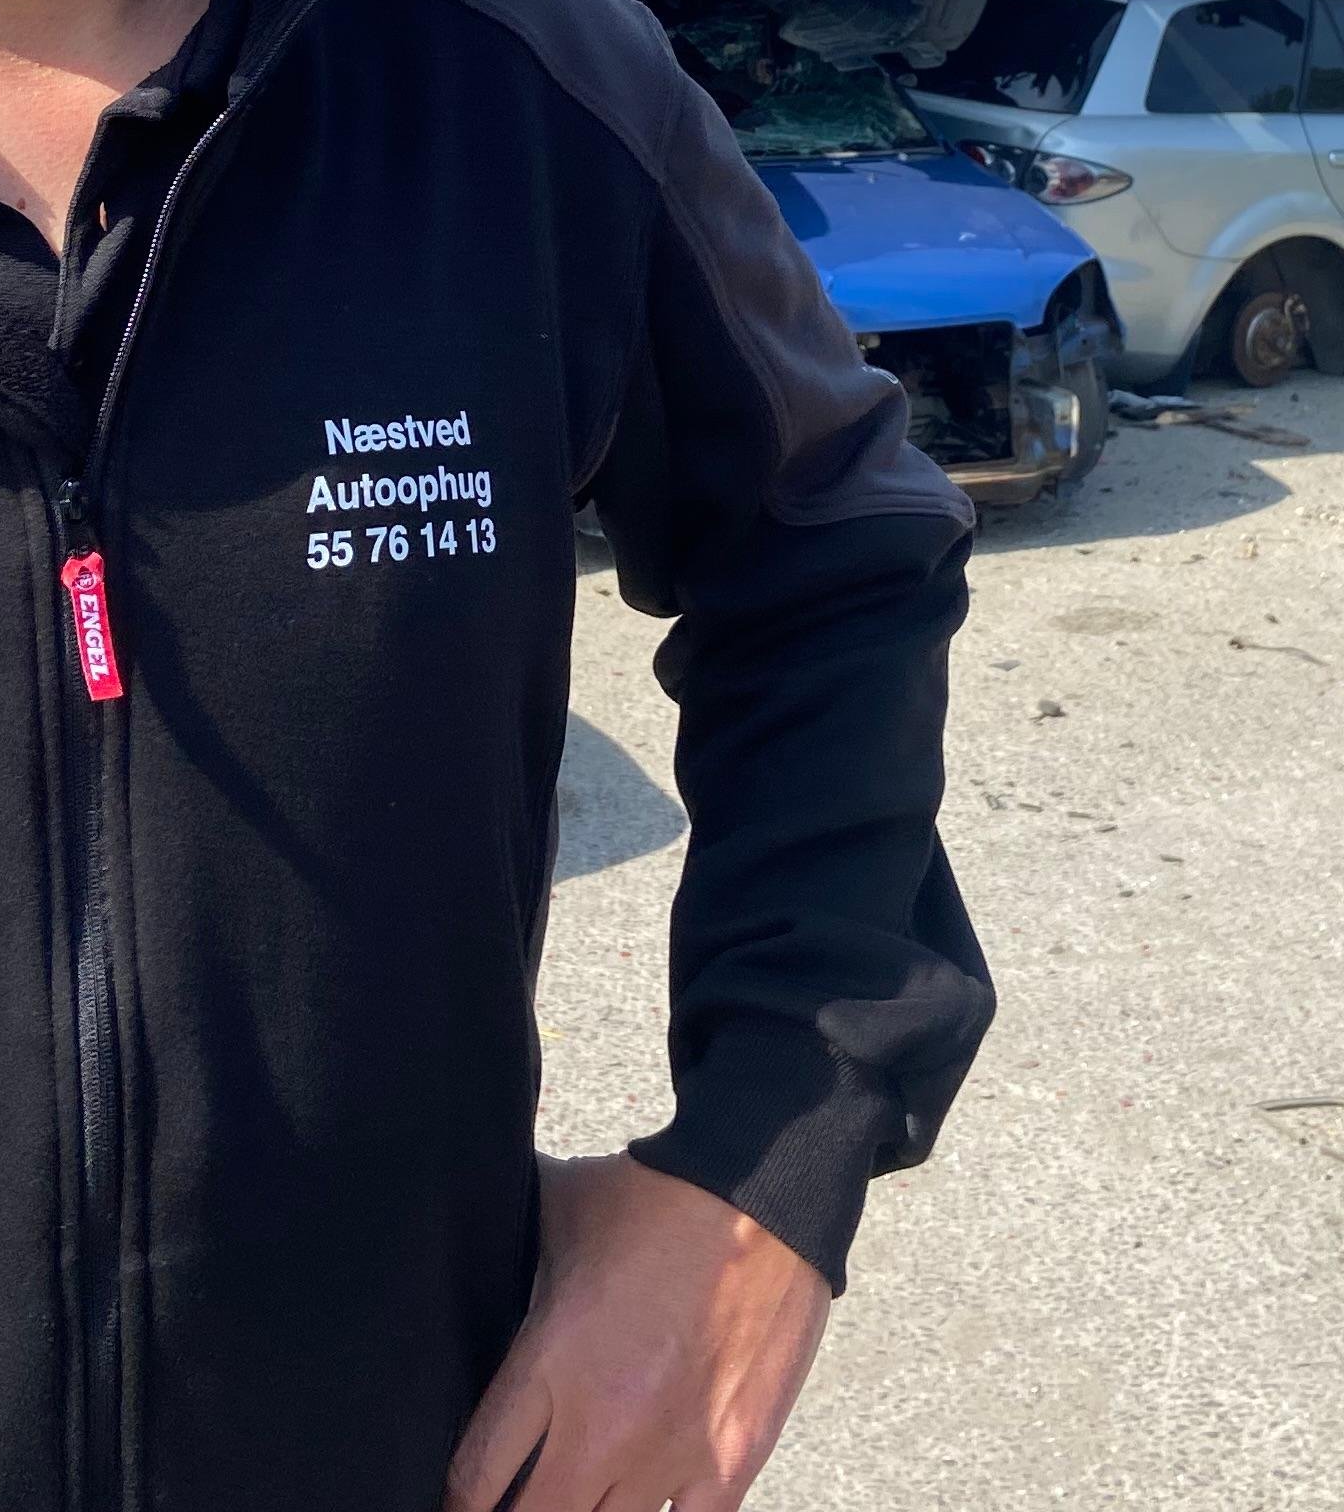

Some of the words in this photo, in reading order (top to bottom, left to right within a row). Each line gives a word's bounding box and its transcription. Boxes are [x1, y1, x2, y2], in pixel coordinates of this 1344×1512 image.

[324, 410, 472, 455] Næstved
[306, 465, 492, 513] Autoophug
[306, 530, 354, 570] 55
[365, 525, 409, 563] 76
[420, 521, 458, 558] 14
[465, 517, 496, 554] 13
[79, 593, 110, 681] ENGEL
